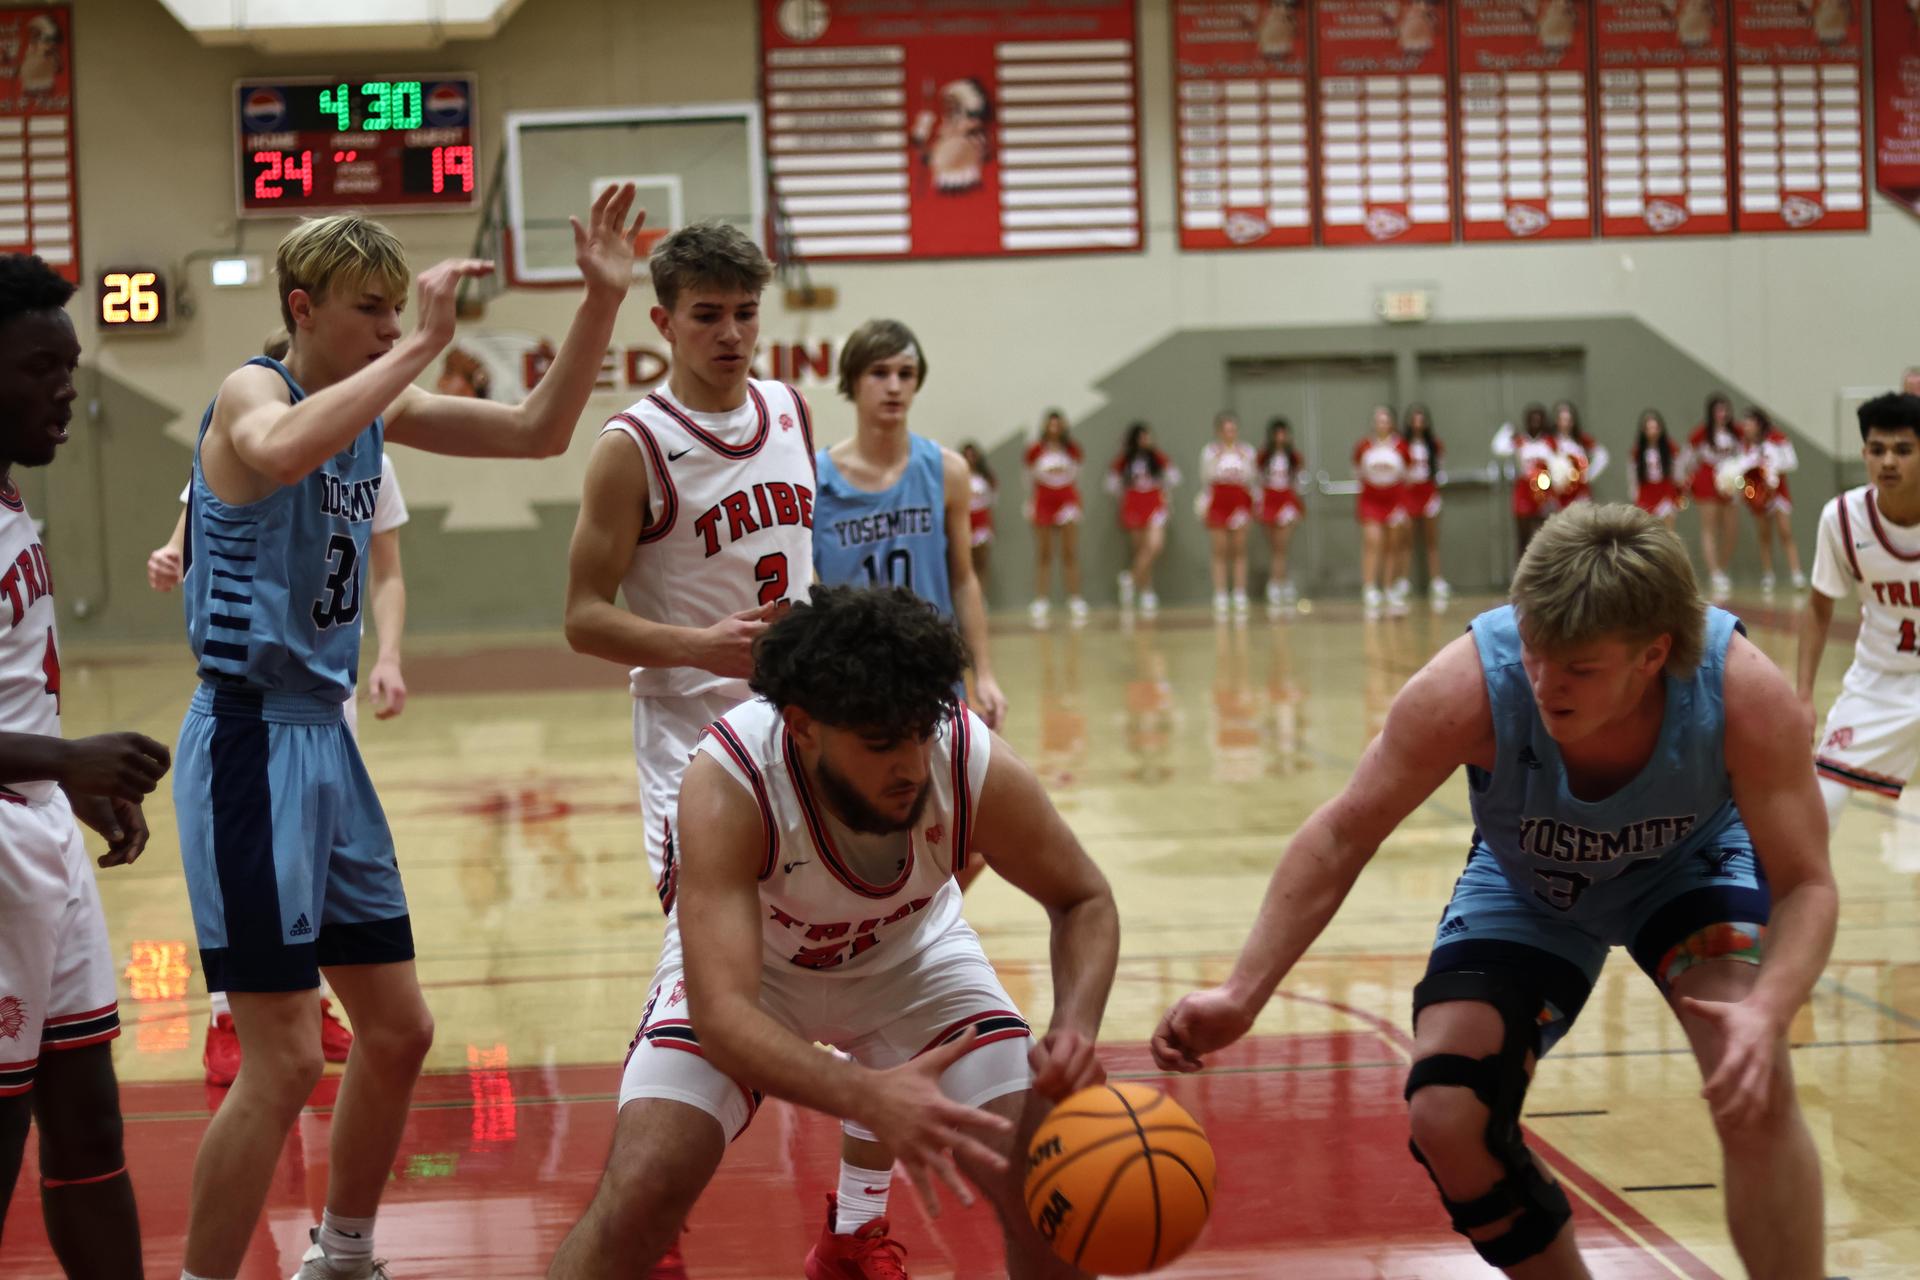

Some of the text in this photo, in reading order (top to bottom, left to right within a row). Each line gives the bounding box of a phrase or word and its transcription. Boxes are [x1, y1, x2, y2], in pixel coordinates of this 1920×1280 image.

[254, 150, 312, 198] 24
[432, 145, 474, 193] 19
[102, 272, 159, 323] 26
[694, 481, 813, 558] TRIBE
[834, 507, 932, 546] YOSEMITE
[862, 549, 912, 590] 10
[1518, 813, 1697, 863] YOSEMITE
